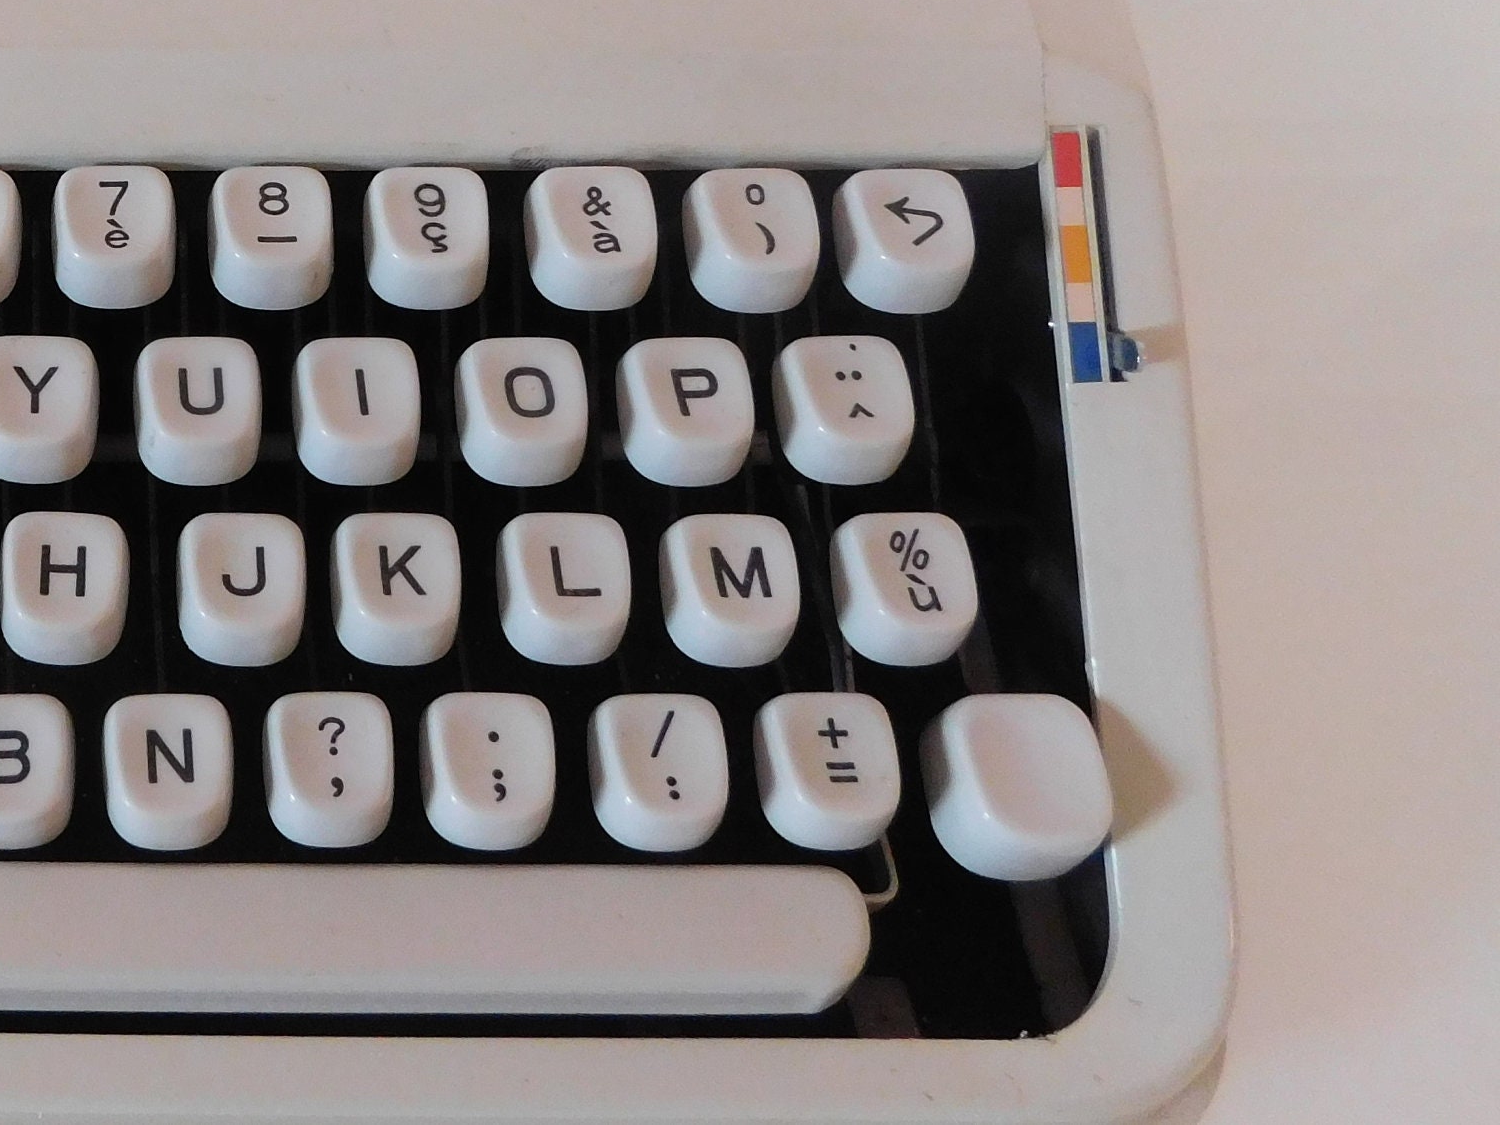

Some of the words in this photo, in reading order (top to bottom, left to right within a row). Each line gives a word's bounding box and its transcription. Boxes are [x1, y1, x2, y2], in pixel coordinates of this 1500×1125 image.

[98, 181, 129, 216] 7
[258, 181, 288, 216] 8
[414, 183, 446, 217] 9
[583, 186, 612, 216] &
[104, 218, 129, 249] è
[421, 221, 449, 254] ç
[590, 221, 622, 254] à
[13, 366, 59, 414] Y
[178, 368, 224, 415] U
[355, 369, 370, 416] I
[504, 367, 556, 418] O
[670, 368, 719, 416] P
[40, 544, 87, 597] H
[379, 545, 427, 596] K
[889, 529, 930, 572] %
[222, 547, 267, 596] J
[550, 546, 602, 597] L
[709, 547, 773, 599] M
[905, 573, 944, 613] ù
[146, 728, 195, 784] N
[318, 717, 346, 756] ?
[492, 769, 507, 802] ;
[666, 776, 681, 801] :
[826, 761, 859, 783] =
